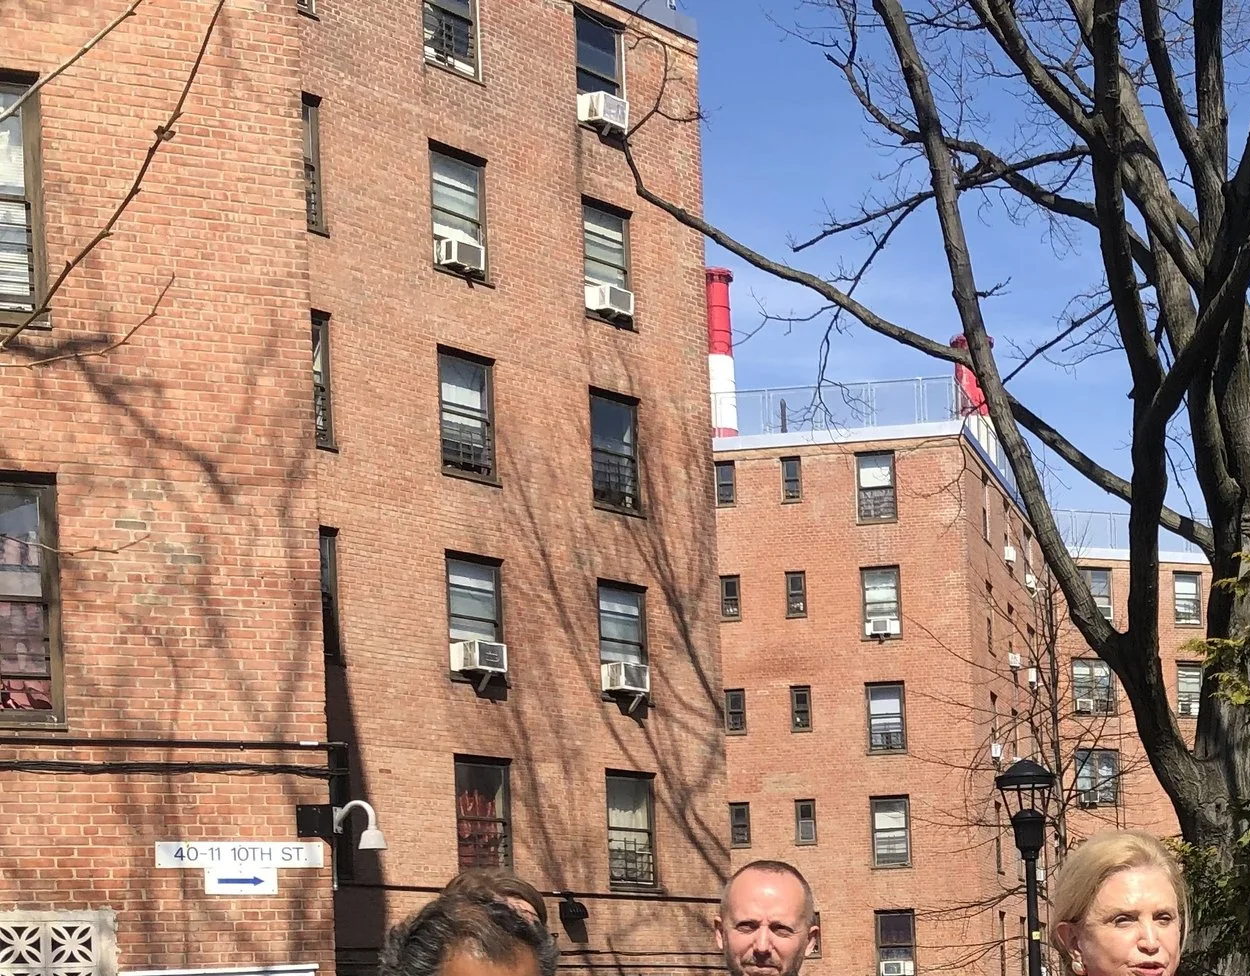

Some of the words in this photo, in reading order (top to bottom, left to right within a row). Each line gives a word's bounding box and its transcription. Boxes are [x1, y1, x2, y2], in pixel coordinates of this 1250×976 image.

[173, 846, 222, 862] 40-11
[230, 846, 273, 862] 10TH
[281, 846, 308, 862] ST.
